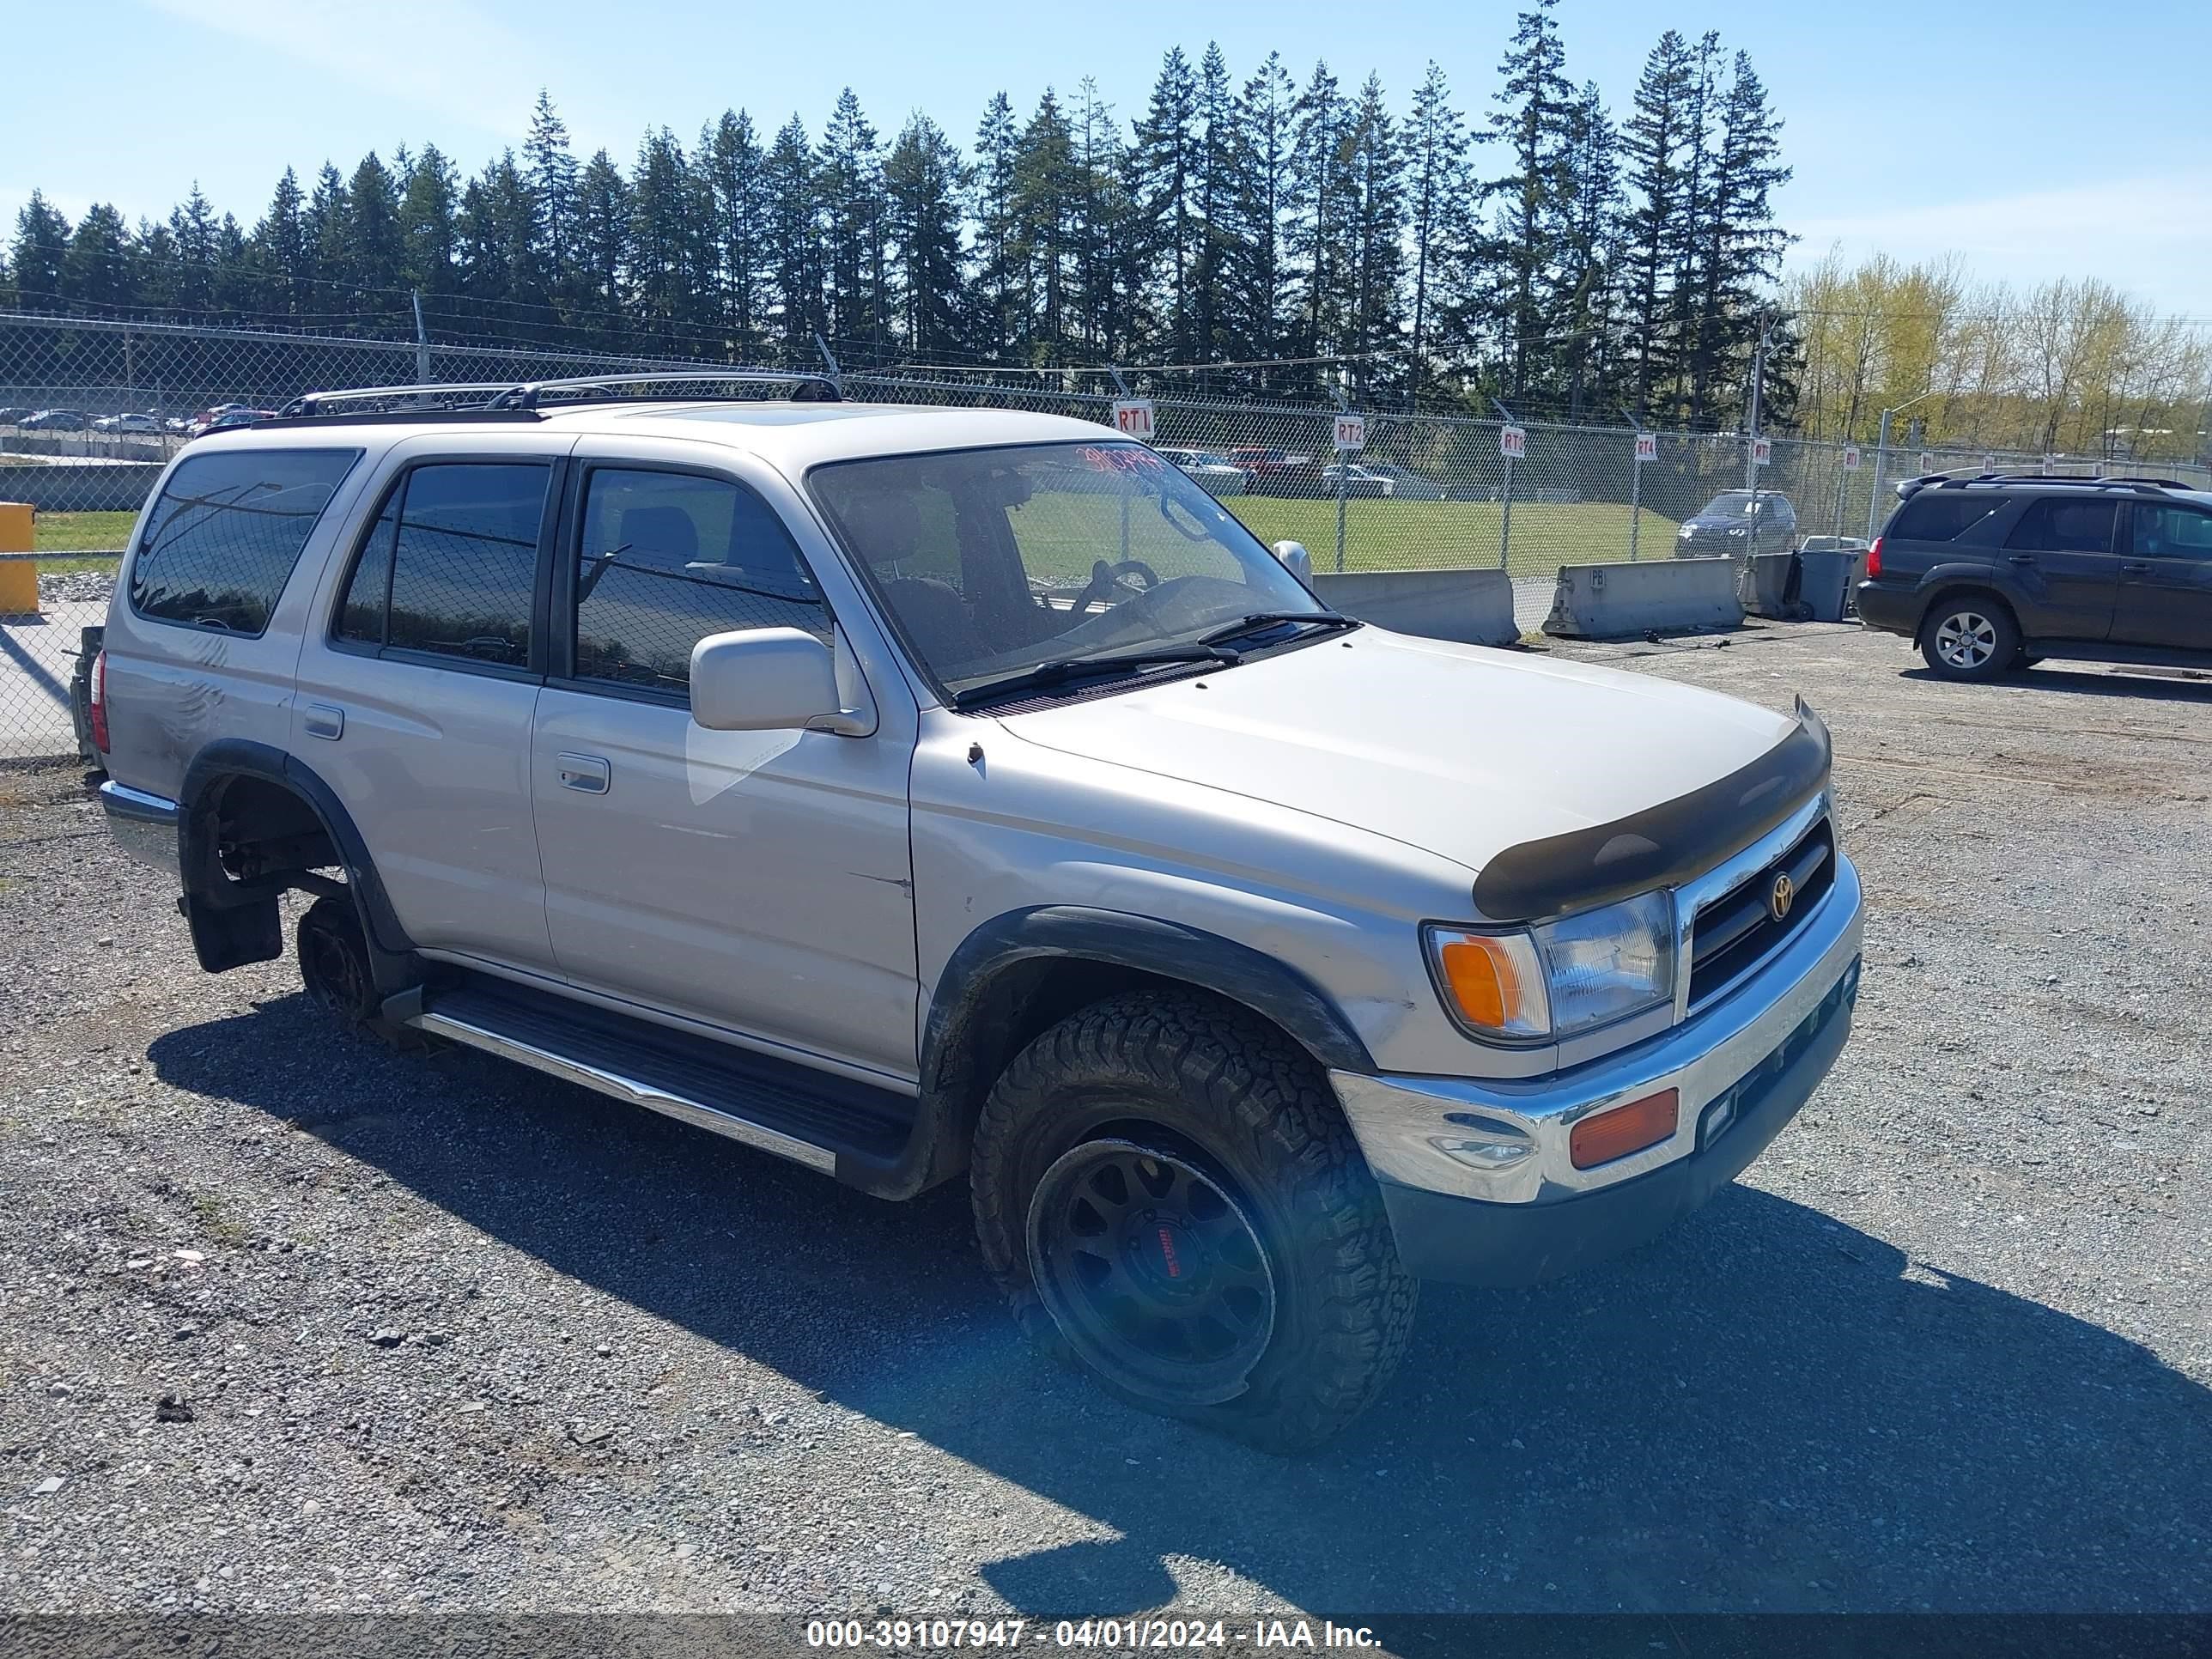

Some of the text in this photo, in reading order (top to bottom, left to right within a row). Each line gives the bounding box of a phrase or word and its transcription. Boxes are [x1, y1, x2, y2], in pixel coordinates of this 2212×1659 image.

[1118, 410, 1149, 432] RT1
[1339, 423, 1362, 442] RT2
[1504, 433, 1523, 451] RT3
[1638, 441, 1654, 455] RT4
